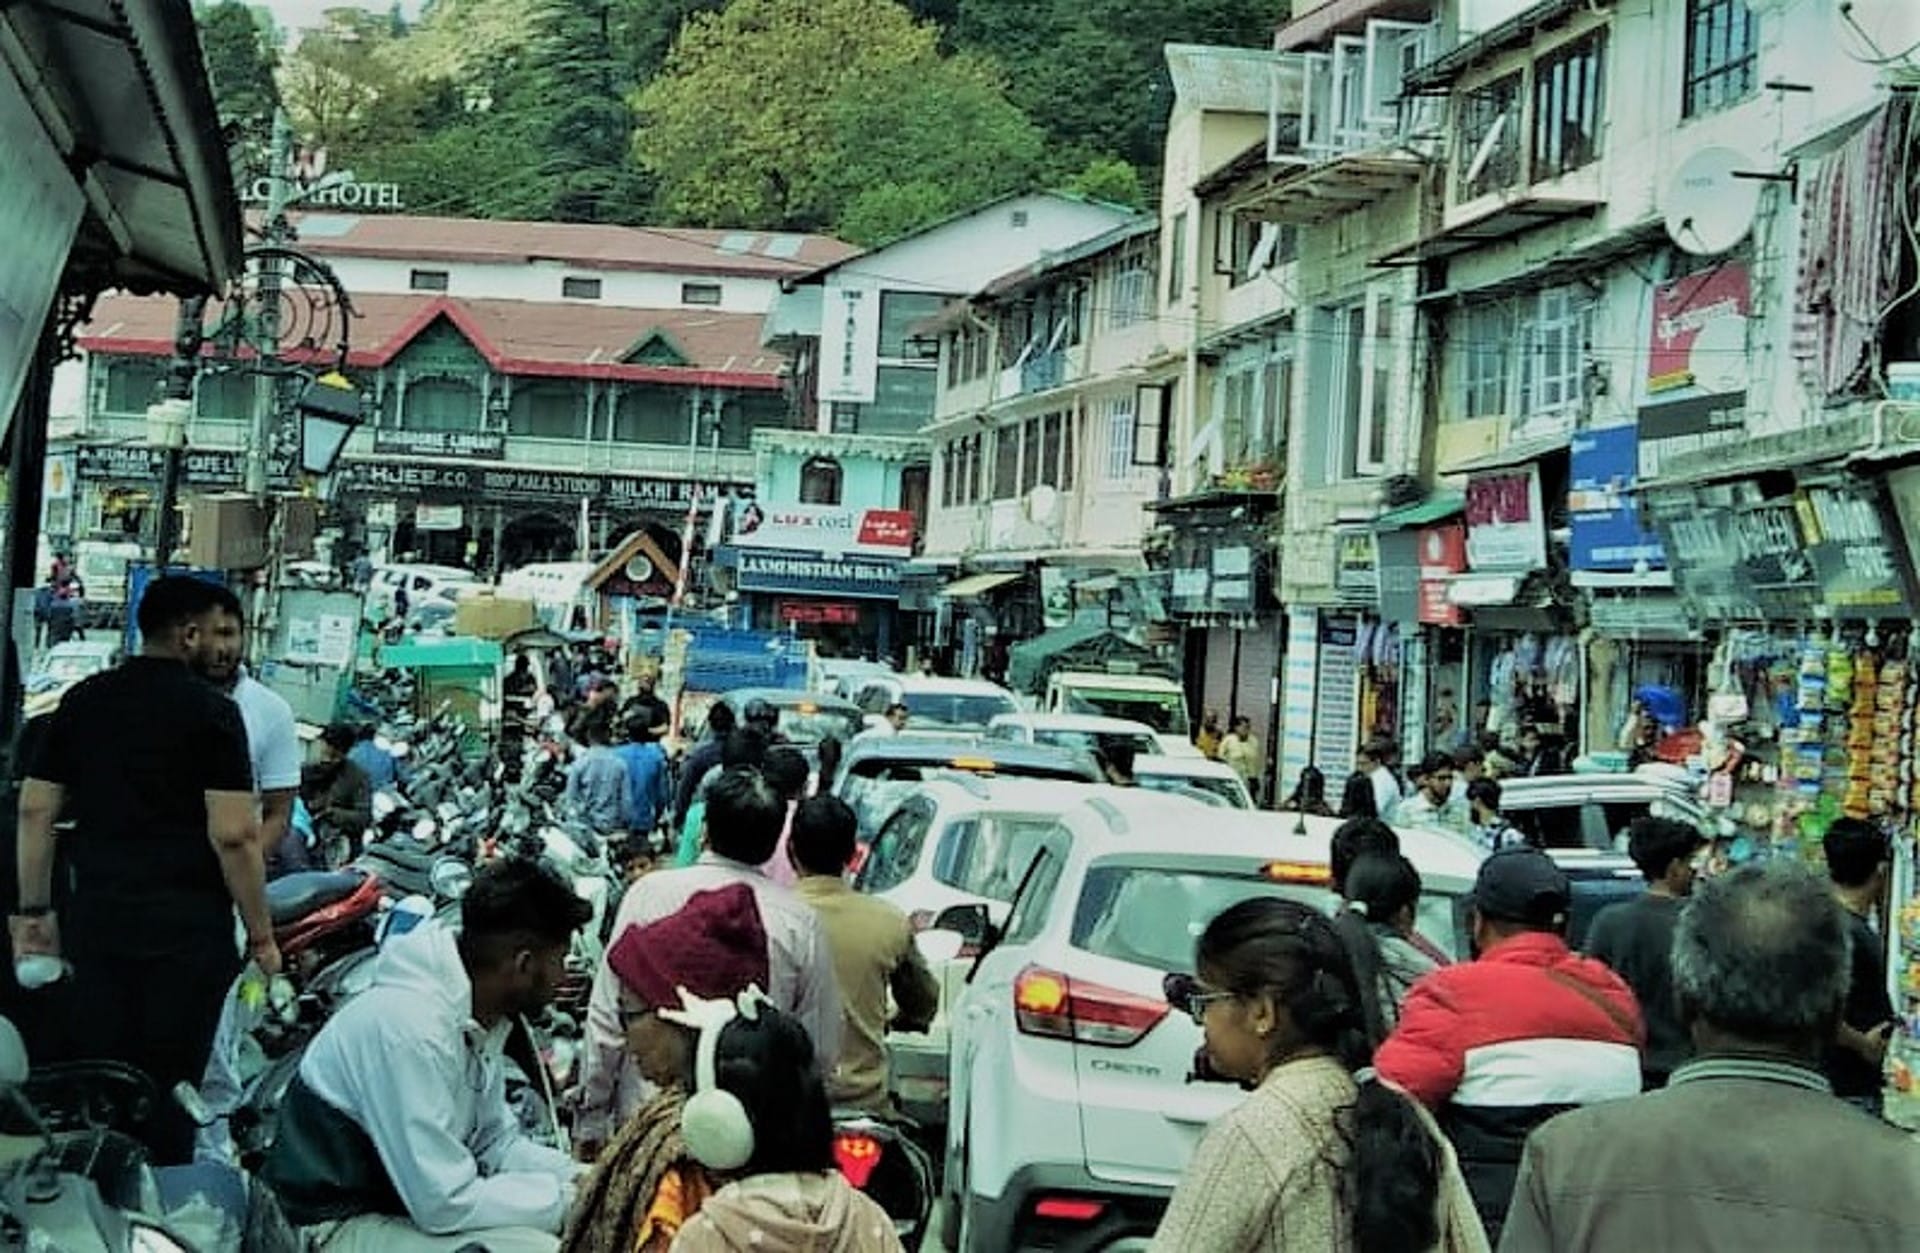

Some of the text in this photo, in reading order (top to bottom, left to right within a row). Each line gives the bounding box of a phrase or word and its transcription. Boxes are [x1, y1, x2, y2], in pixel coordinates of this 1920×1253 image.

[319, 182, 405, 208] HOTEL
[517, 473, 551, 491] KALA
[553, 475, 601, 493] STUDIO
[610, 478, 672, 500] MILKHI
[772, 513, 814, 527] LUX
[1090, 1058, 1161, 1077] CRETA
